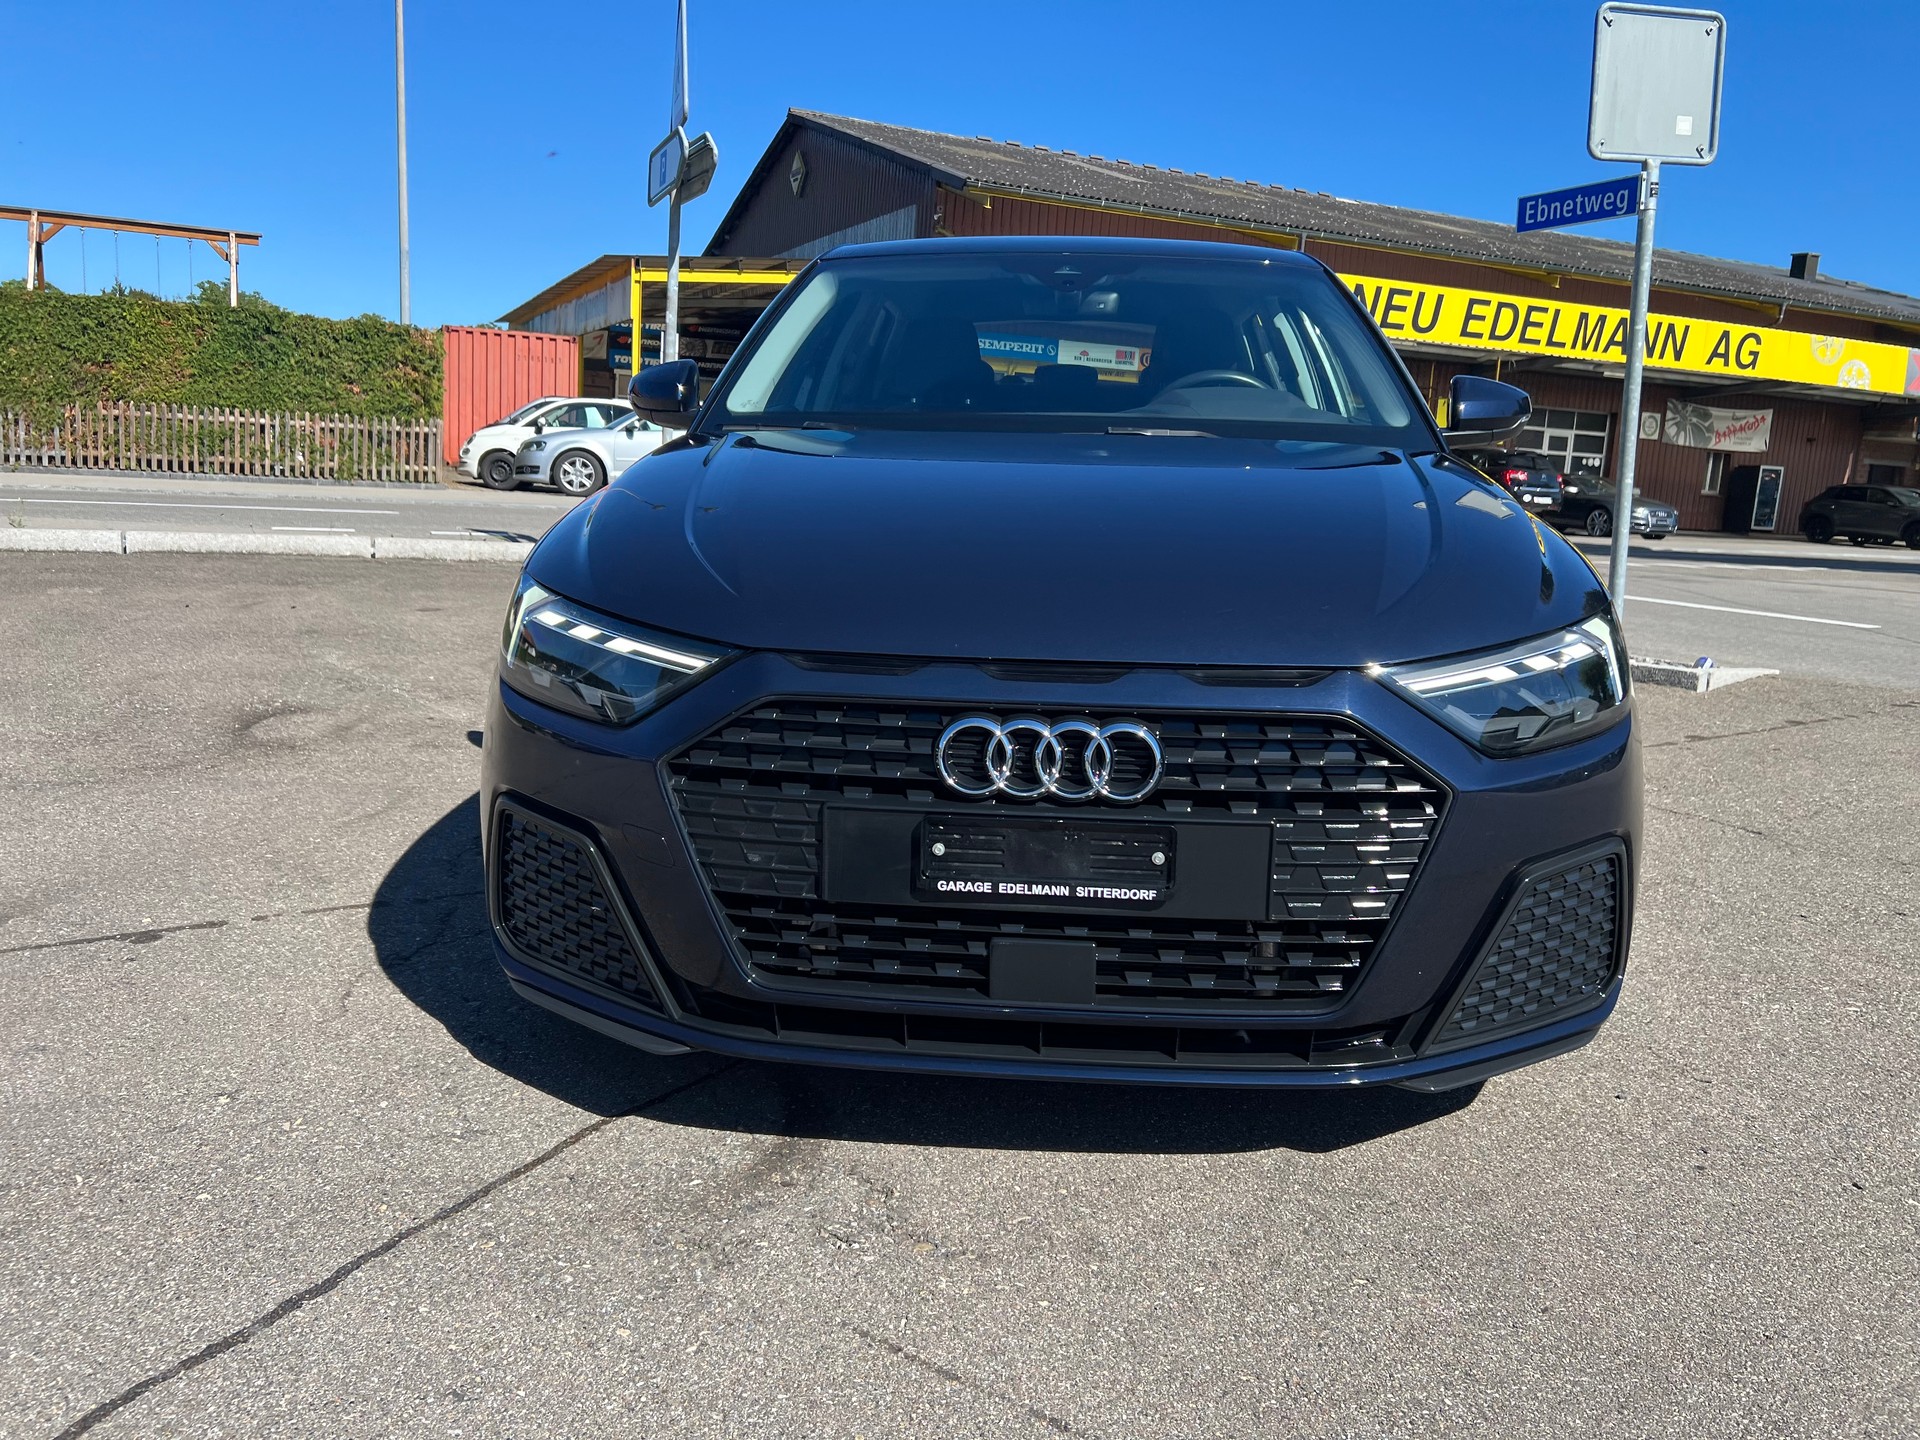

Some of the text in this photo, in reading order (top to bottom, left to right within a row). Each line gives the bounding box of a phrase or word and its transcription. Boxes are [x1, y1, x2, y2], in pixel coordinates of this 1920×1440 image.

[1525, 190, 1629, 224] Ebnetweg
[978, 338, 1045, 354] SEMPERIT
[1460, 297, 1690, 362] EDELMANN
[1705, 331, 1762, 371] AG
[937, 880, 1157, 901] GARAGE EDELMANN SITTERDORF
